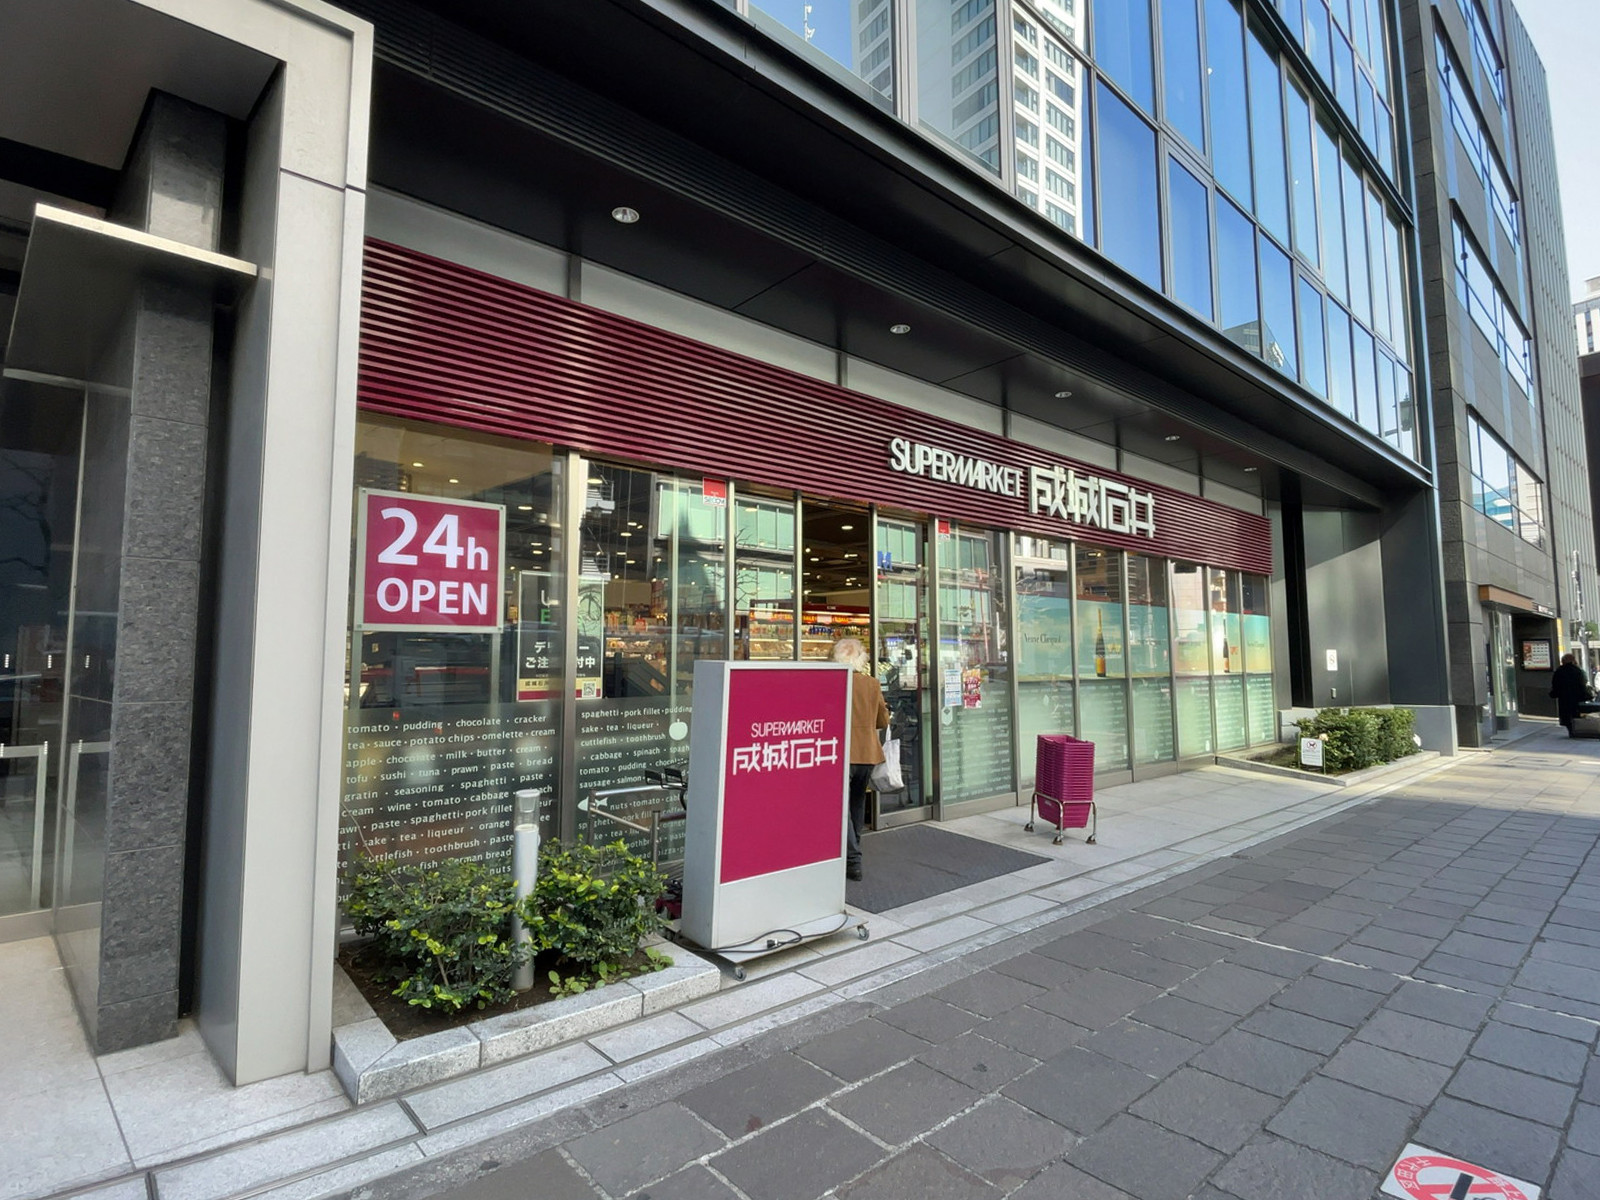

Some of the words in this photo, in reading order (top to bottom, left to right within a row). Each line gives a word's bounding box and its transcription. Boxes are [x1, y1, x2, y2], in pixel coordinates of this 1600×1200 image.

[889, 437, 1023, 498] SUPERMARKET
[1029, 465, 1156, 538] 成城石井
[377, 507, 489, 571] 24h
[376, 577, 487, 615] OPEN
[347, 724, 390, 734] tomato
[403, 720, 443, 732] pudding
[455, 717, 501, 728] chocolate
[513, 714, 547, 724] cracker
[581, 709, 619, 719] spaghetti
[624, 708, 641, 718] pork
[643, 707, 661, 716] fillet
[347, 742, 365, 750] tea
[373, 739, 402, 748] sauce
[409, 736, 446, 747] potato
[447, 733, 475, 744] chips
[481, 730, 524, 740] omelette
[530, 728, 556, 737] cream
[581, 725, 599, 734] sake
[606, 724, 619, 732] tea
[627, 722, 654, 731] liqueur
[751, 719, 825, 738] SUPERMARKET
[580, 737, 617, 747] cuttlefish
[626, 733, 666, 743] toothbrush
[345, 757, 377, 769] apple
[445, 750, 468, 760] milk
[476, 748, 506, 757] butter
[515, 745, 541, 754] cream
[590, 751, 623, 761] cabbage
[633, 746, 661, 757] spinach
[733, 736, 838, 776] 成城石井
[346, 774, 368, 784] tofu
[380, 770, 406, 781] sushi
[451, 765, 478, 776] prawn
[490, 761, 515, 771] paste
[526, 756, 553, 767] bread
[579, 766, 610, 776] tomato
[618, 762, 647, 772] pudding
[344, 790, 378, 803] gratin
[394, 784, 444, 796] seasoning
[460, 776, 507, 789] spaghetti
[520, 773, 544, 783] paste
[579, 779, 611, 789] sausage
[616, 775, 642, 784] salmon
[341, 807, 374, 818] cream
[387, 802, 412, 812] wine
[422, 796, 461, 808] tomato
[470, 791, 509, 802] cabbage
[609, 802, 628, 811] nuts
[632, 798, 660, 807] tomato
[371, 820, 401, 831] paste
[410, 809, 460, 825] spaghetti
[465, 807, 488, 819] pork
[490, 804, 513, 814] fillet
[400, 832, 417, 842] tea
[427, 826, 464, 838] liqueur
[479, 820, 510, 830] orange
[424, 838, 480, 854] toothbrush
[489, 834, 515, 845] paste
[419, 860, 438, 870] fish
[485, 848, 512, 860] bread
[489, 865, 511, 875] nuts
